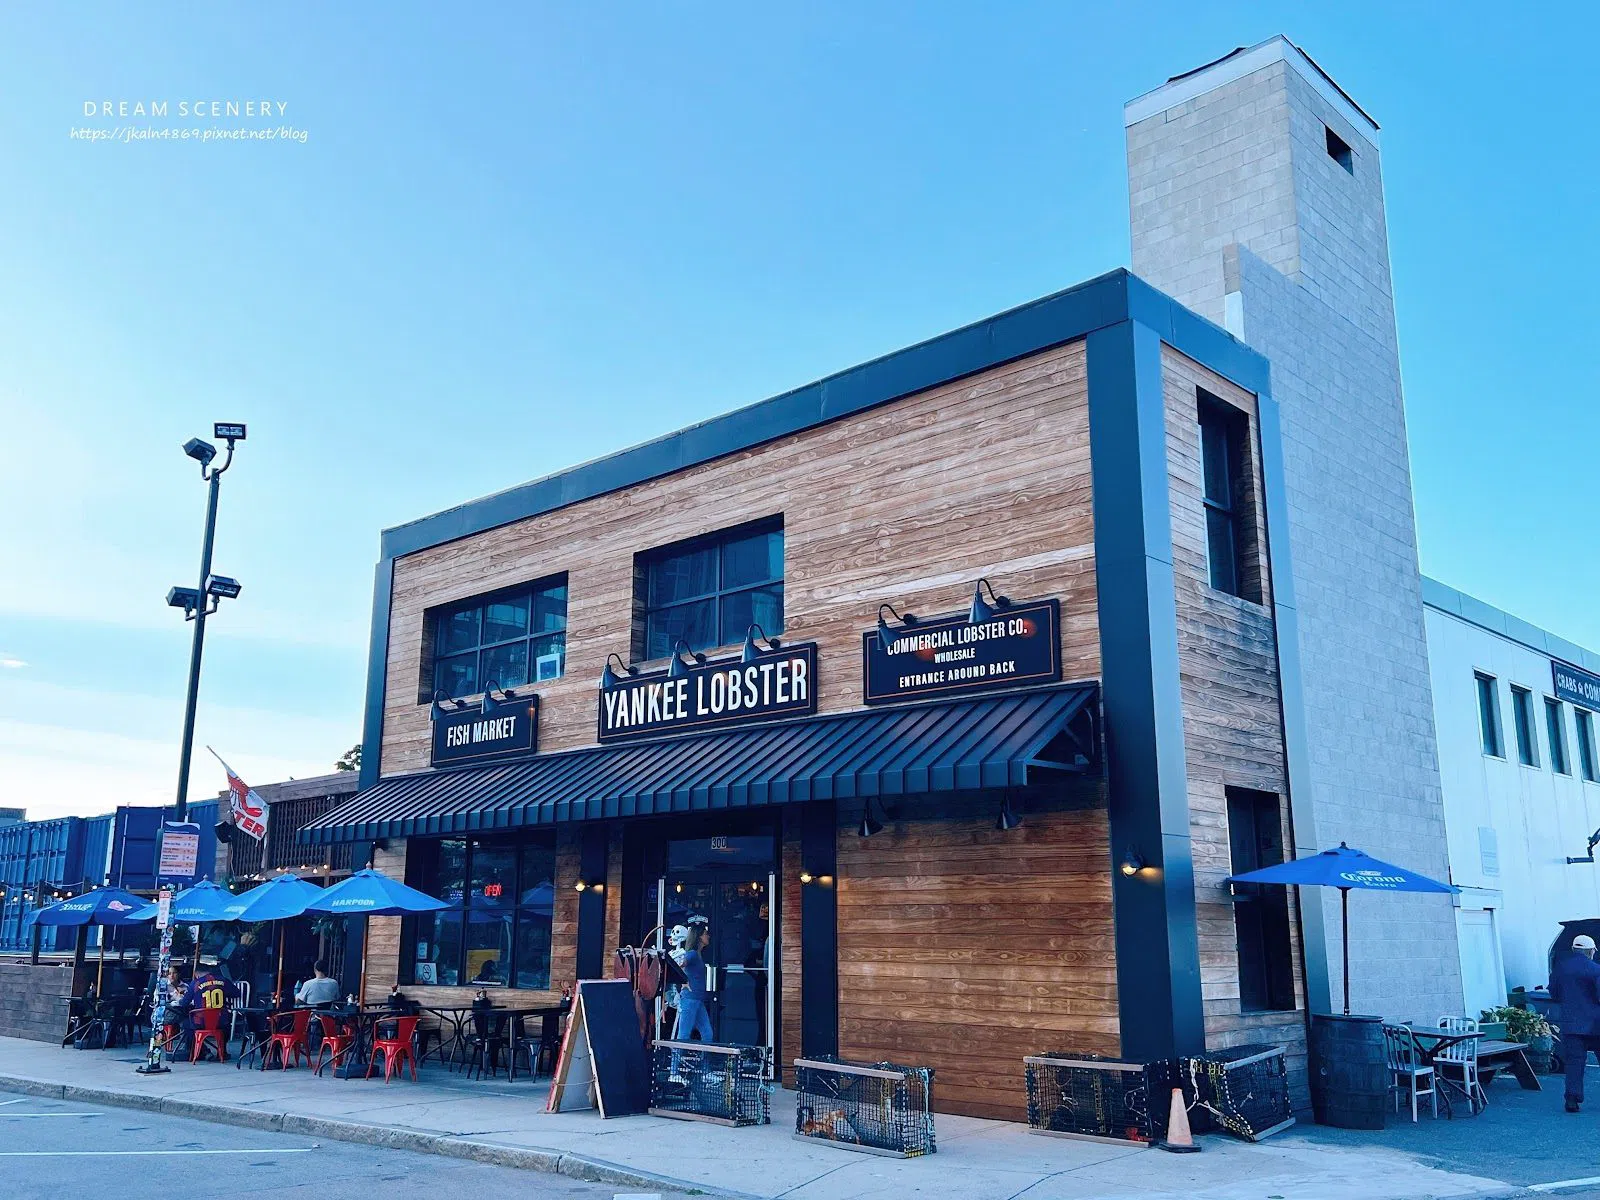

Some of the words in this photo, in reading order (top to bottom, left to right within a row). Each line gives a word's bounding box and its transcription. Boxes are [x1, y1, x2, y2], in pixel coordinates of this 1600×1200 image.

[887, 632, 955, 655] COMMERCIAL
[957, 622, 1005, 643] LOBSTER
[1008, 618, 1028, 636] CO.
[934, 648, 975, 663] WHOLESALE
[899, 671, 945, 688] ENTRANCE
[948, 665, 986, 681] AROUND
[989, 661, 1015, 675] BACK
[1557, 673, 1577, 693] CRABS
[1584, 682, 1600, 702] COM
[604, 678, 688, 730] YANKEE
[696, 658, 807, 716] LOBSTER
[446, 724, 470, 747] FISH
[472, 716, 516, 743] MARKET
[234, 810, 265, 838] TER
[1340, 872, 1406, 882] Corona
[202, 988, 224, 1009] 10
